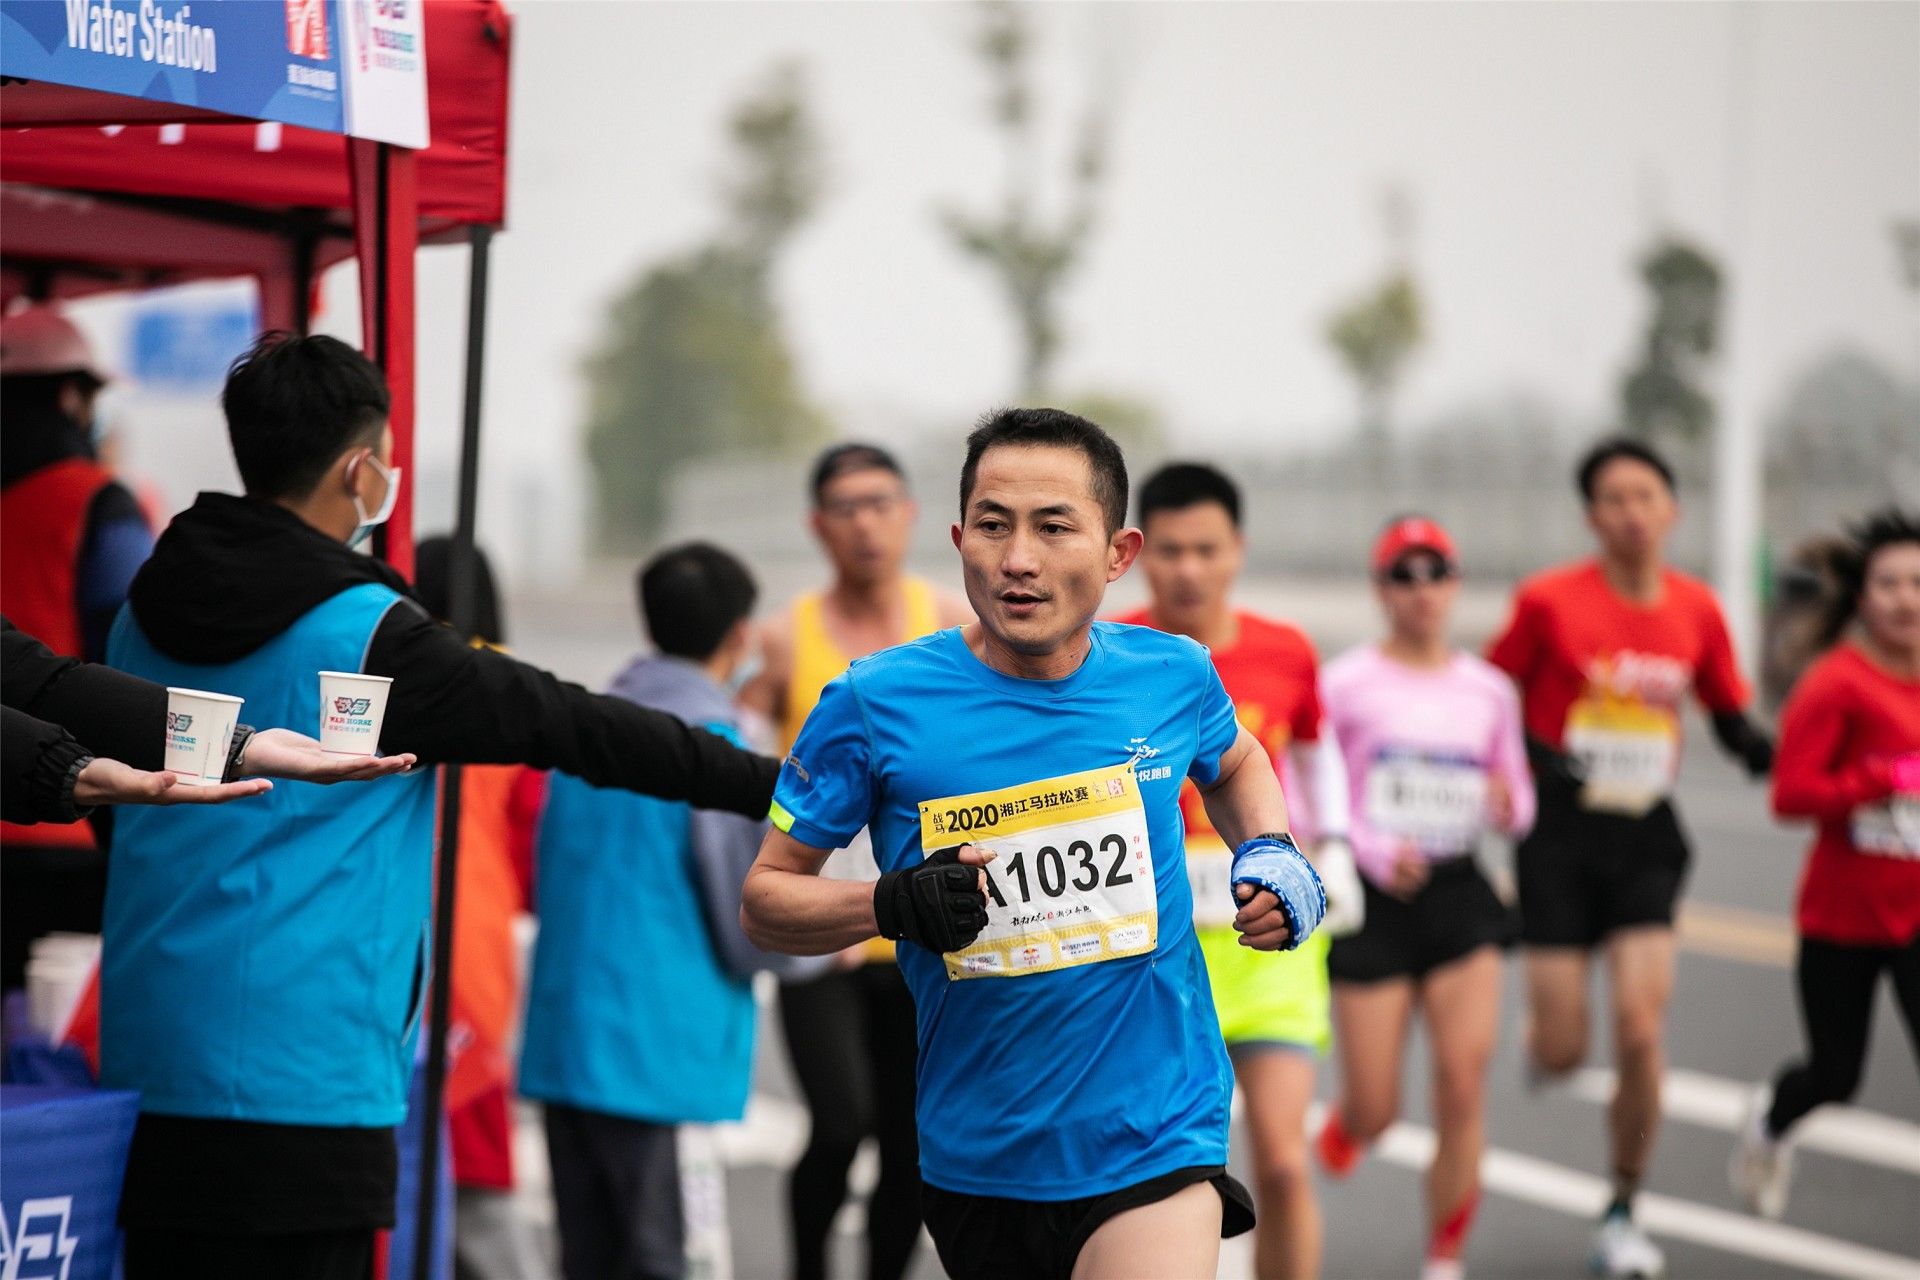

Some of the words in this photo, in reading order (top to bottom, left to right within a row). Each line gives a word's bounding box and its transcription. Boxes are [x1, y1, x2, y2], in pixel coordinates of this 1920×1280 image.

[66, 0, 136, 57] Water
[139, 0, 217, 73] Station
[1136, 766, 1171, 783] 悦跑团
[999, 786, 1089, 818] 湘江马拉松赛
[945, 804, 999, 833] 2020
